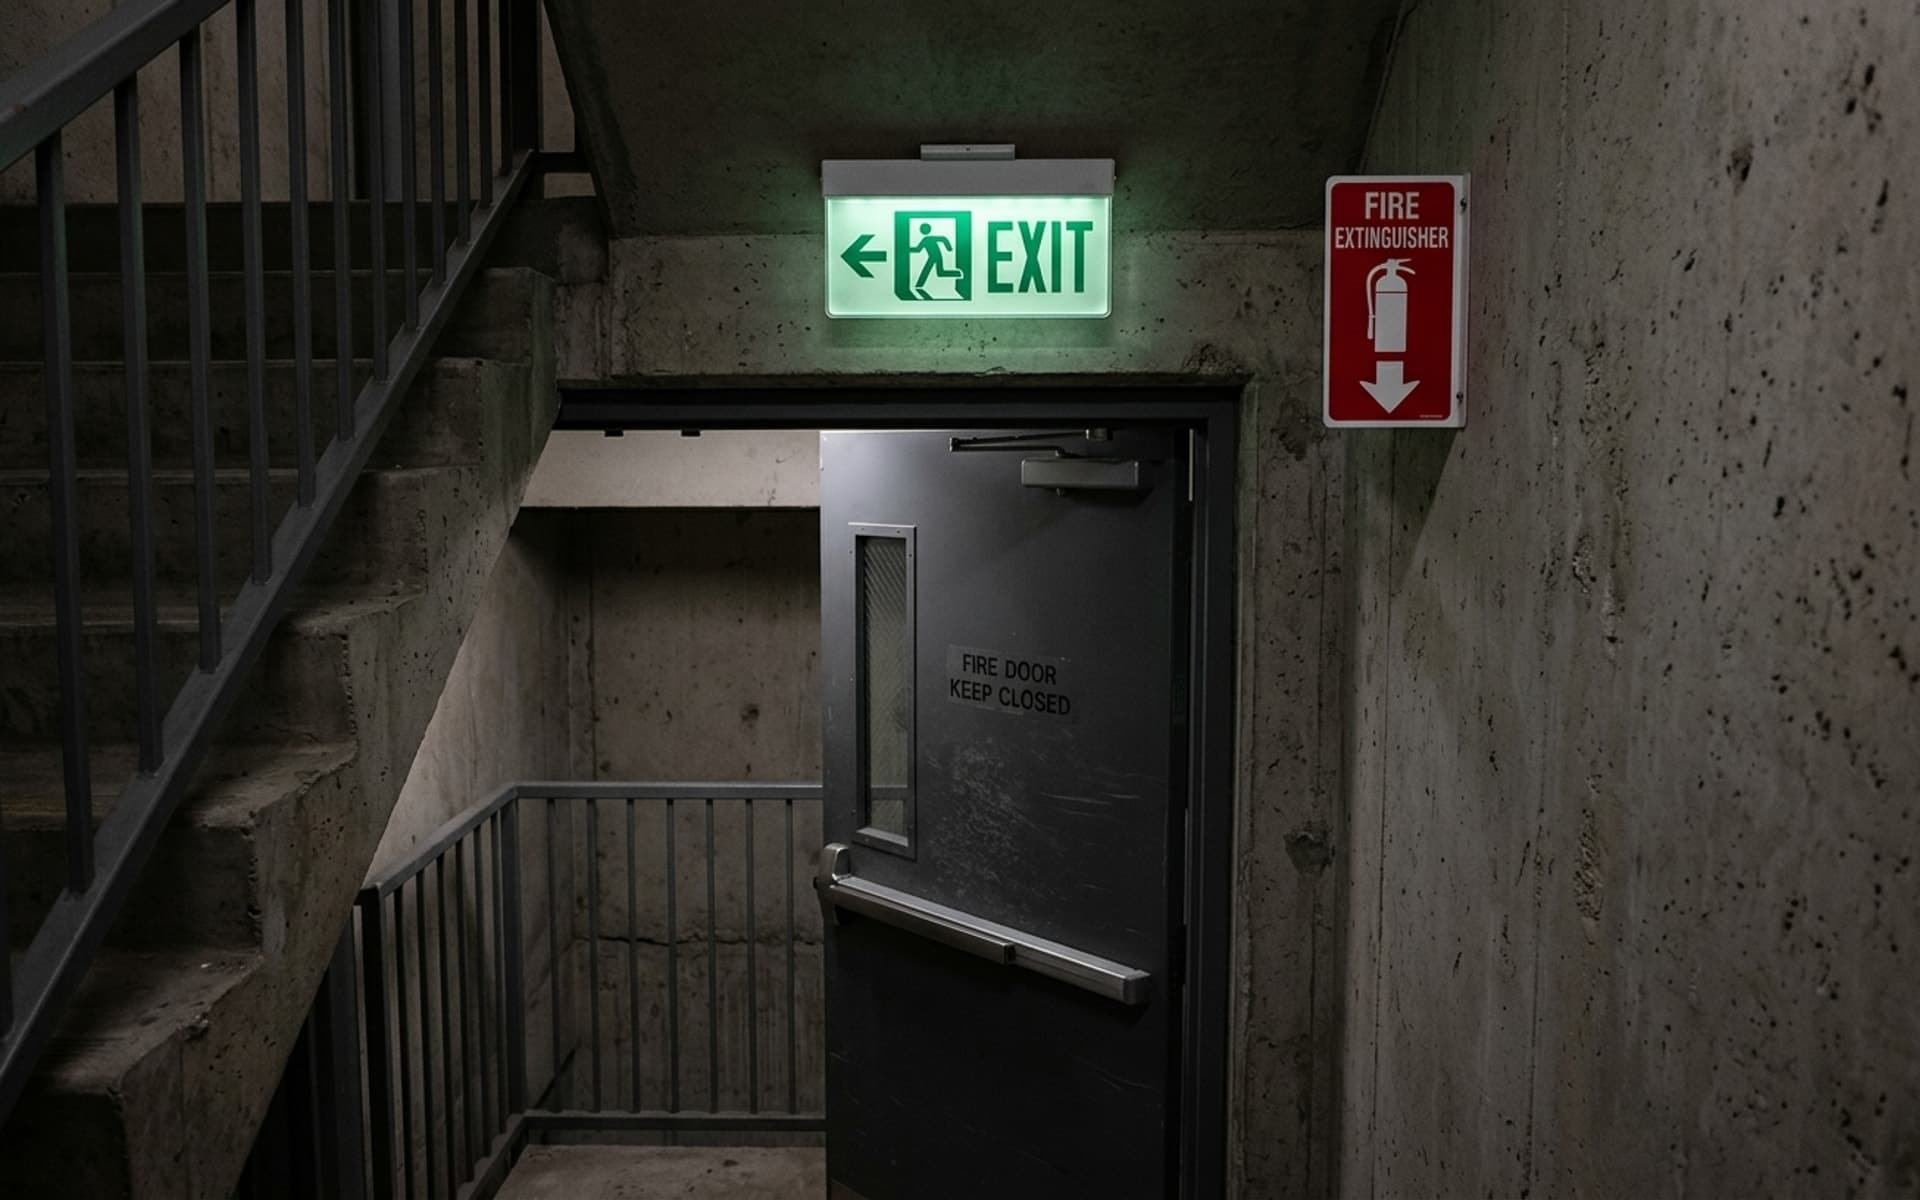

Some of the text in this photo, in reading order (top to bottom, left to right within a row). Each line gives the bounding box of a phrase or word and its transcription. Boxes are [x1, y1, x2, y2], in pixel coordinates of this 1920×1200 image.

[1365, 191, 1420, 220] FIRE
[1335, 226, 1449, 249] EXTINGUISHER
[987, 221, 1093, 293] EXIT
[963, 654, 1057, 685] FIRE DOOR
[950, 678, 1071, 715] KEEP CLOSED
